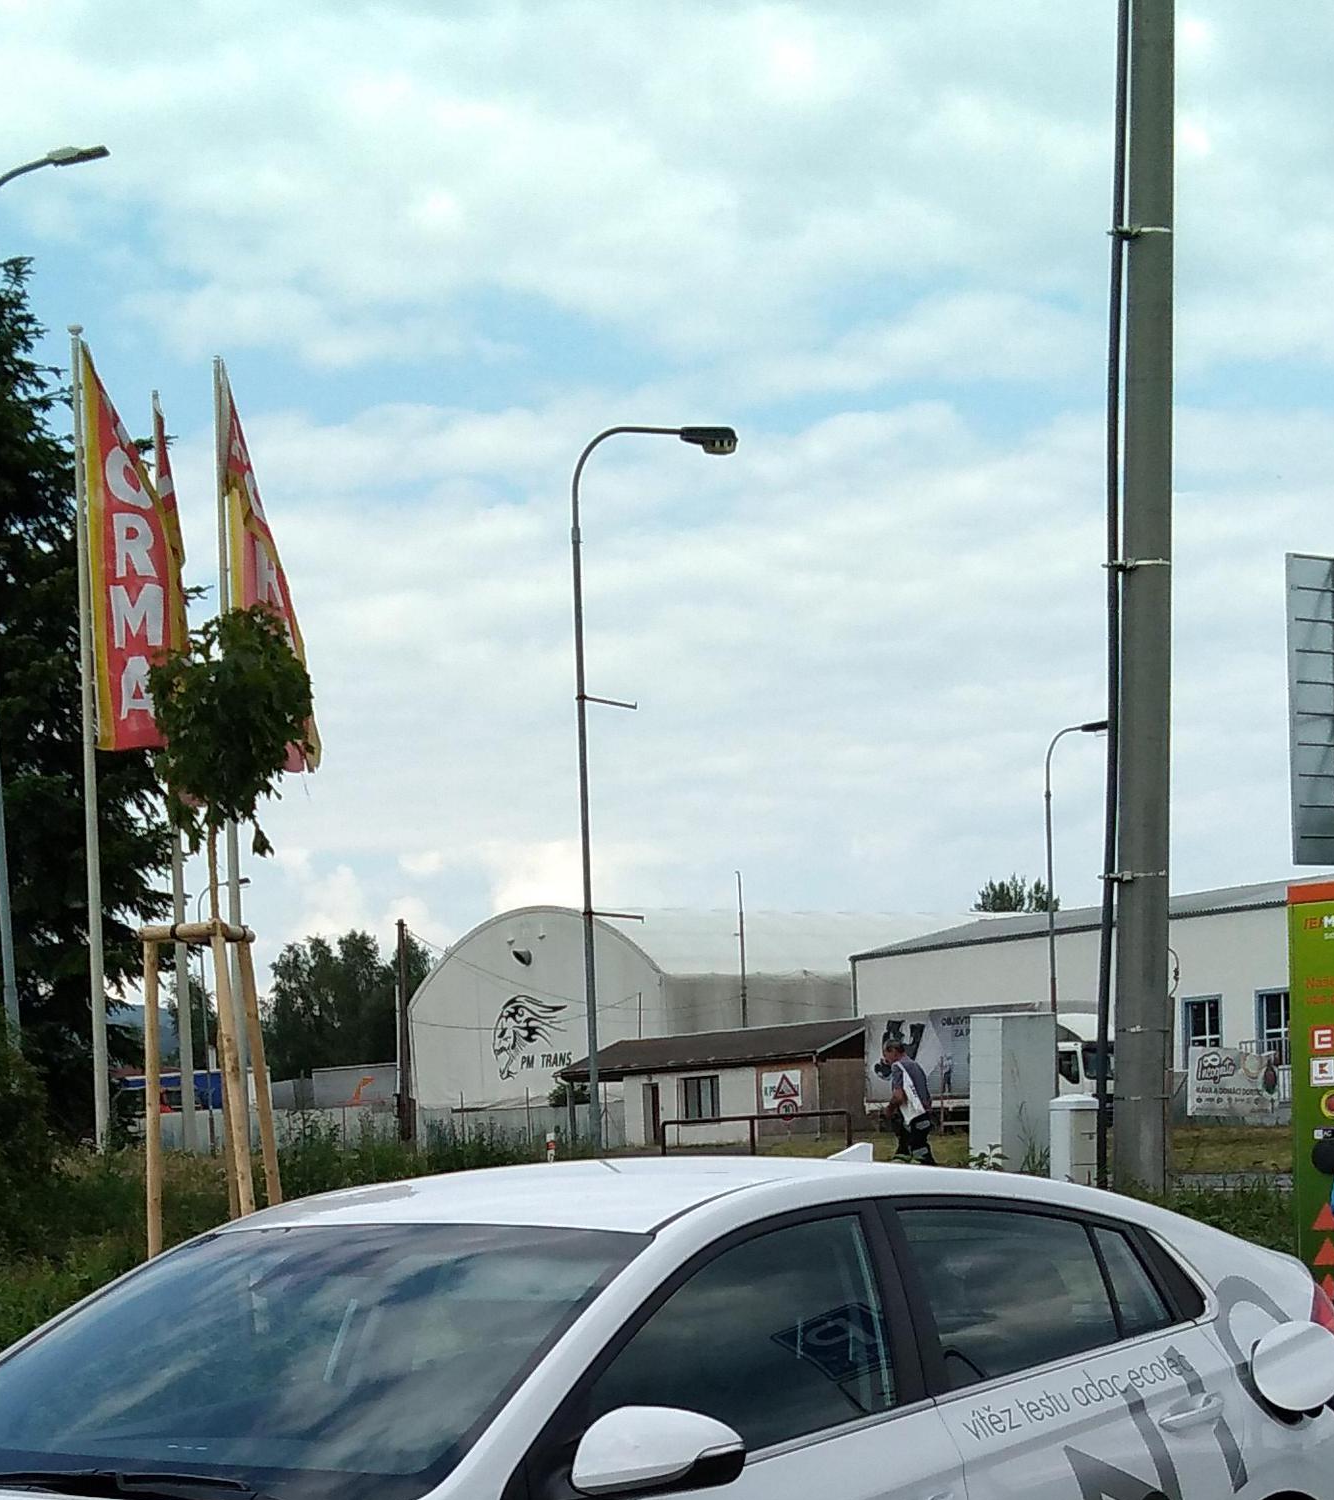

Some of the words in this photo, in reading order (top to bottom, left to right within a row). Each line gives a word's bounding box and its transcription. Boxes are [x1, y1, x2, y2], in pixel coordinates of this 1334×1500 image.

[521, 1055, 535, 1070] PM
[541, 1051, 572, 1068] TRANS
[963, 1405, 1022, 1441] vítěz
[1018, 1390, 1071, 1424] testu
[1072, 1369, 1127, 1407] adac
